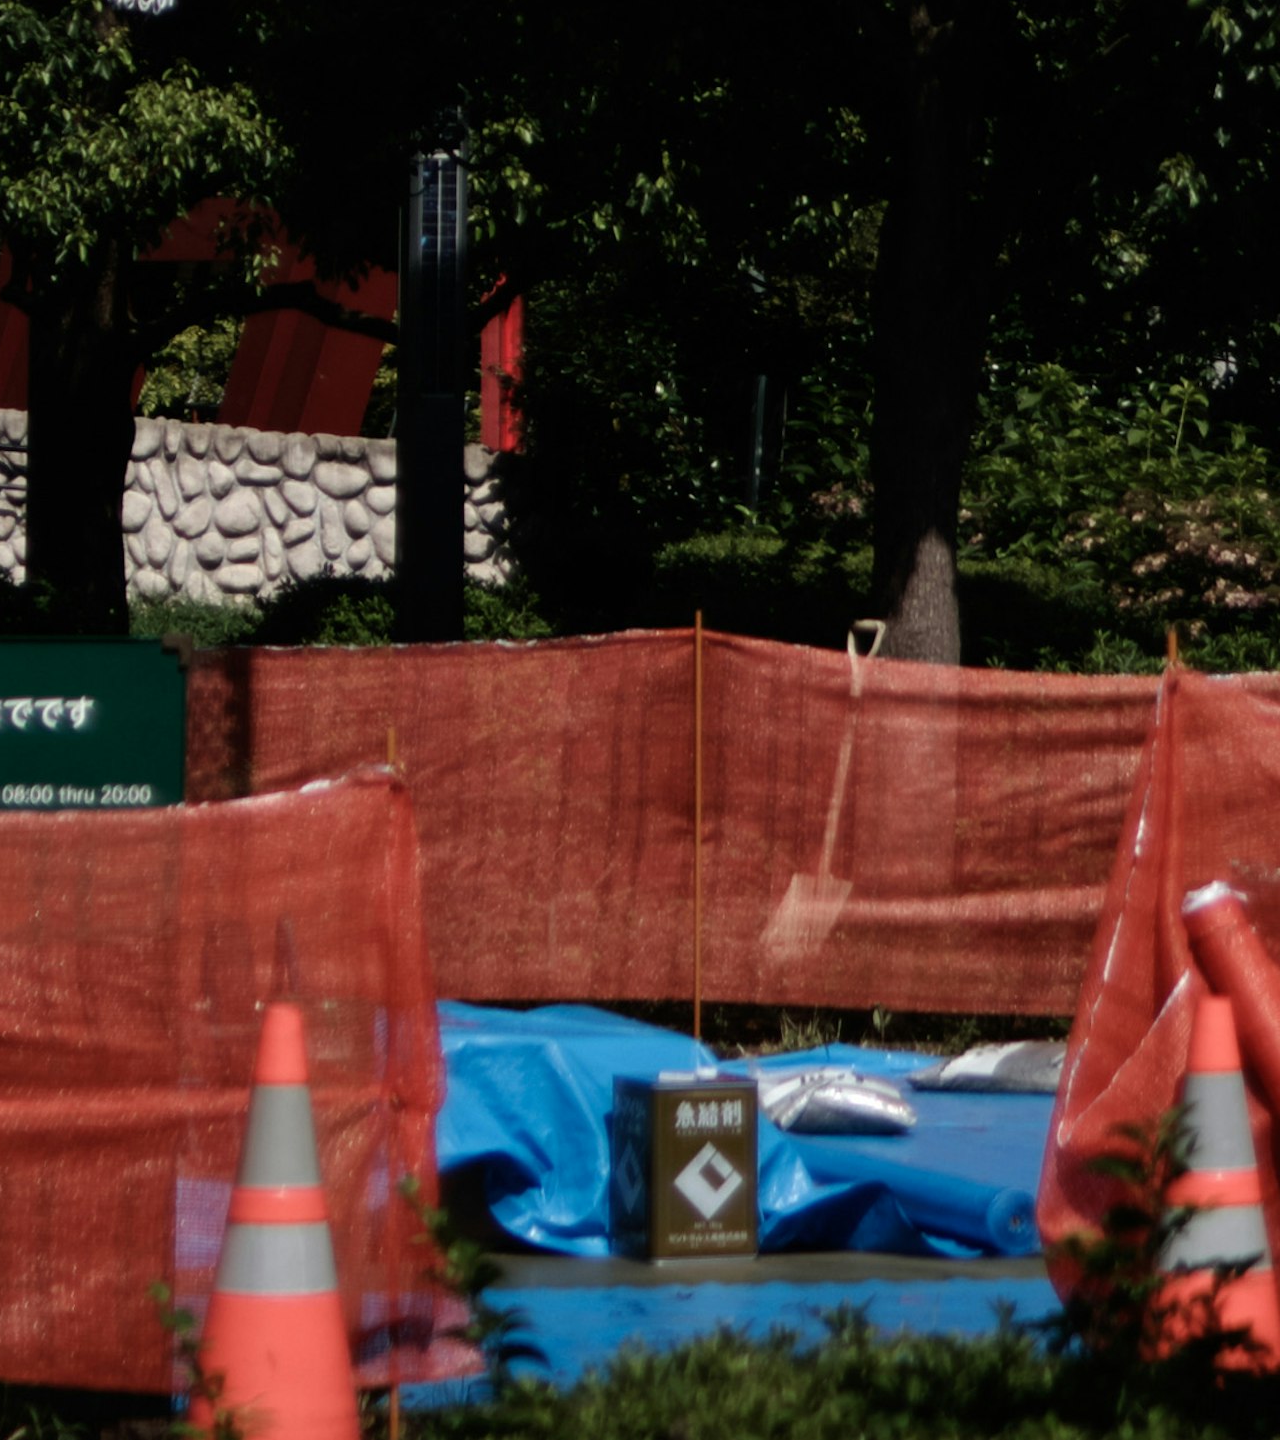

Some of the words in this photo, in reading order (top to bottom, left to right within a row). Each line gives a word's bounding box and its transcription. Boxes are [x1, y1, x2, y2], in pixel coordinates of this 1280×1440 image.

[1, 784, 54, 804] 08:00
[59, 785, 96, 804] thru
[100, 784, 152, 804] 20:00
